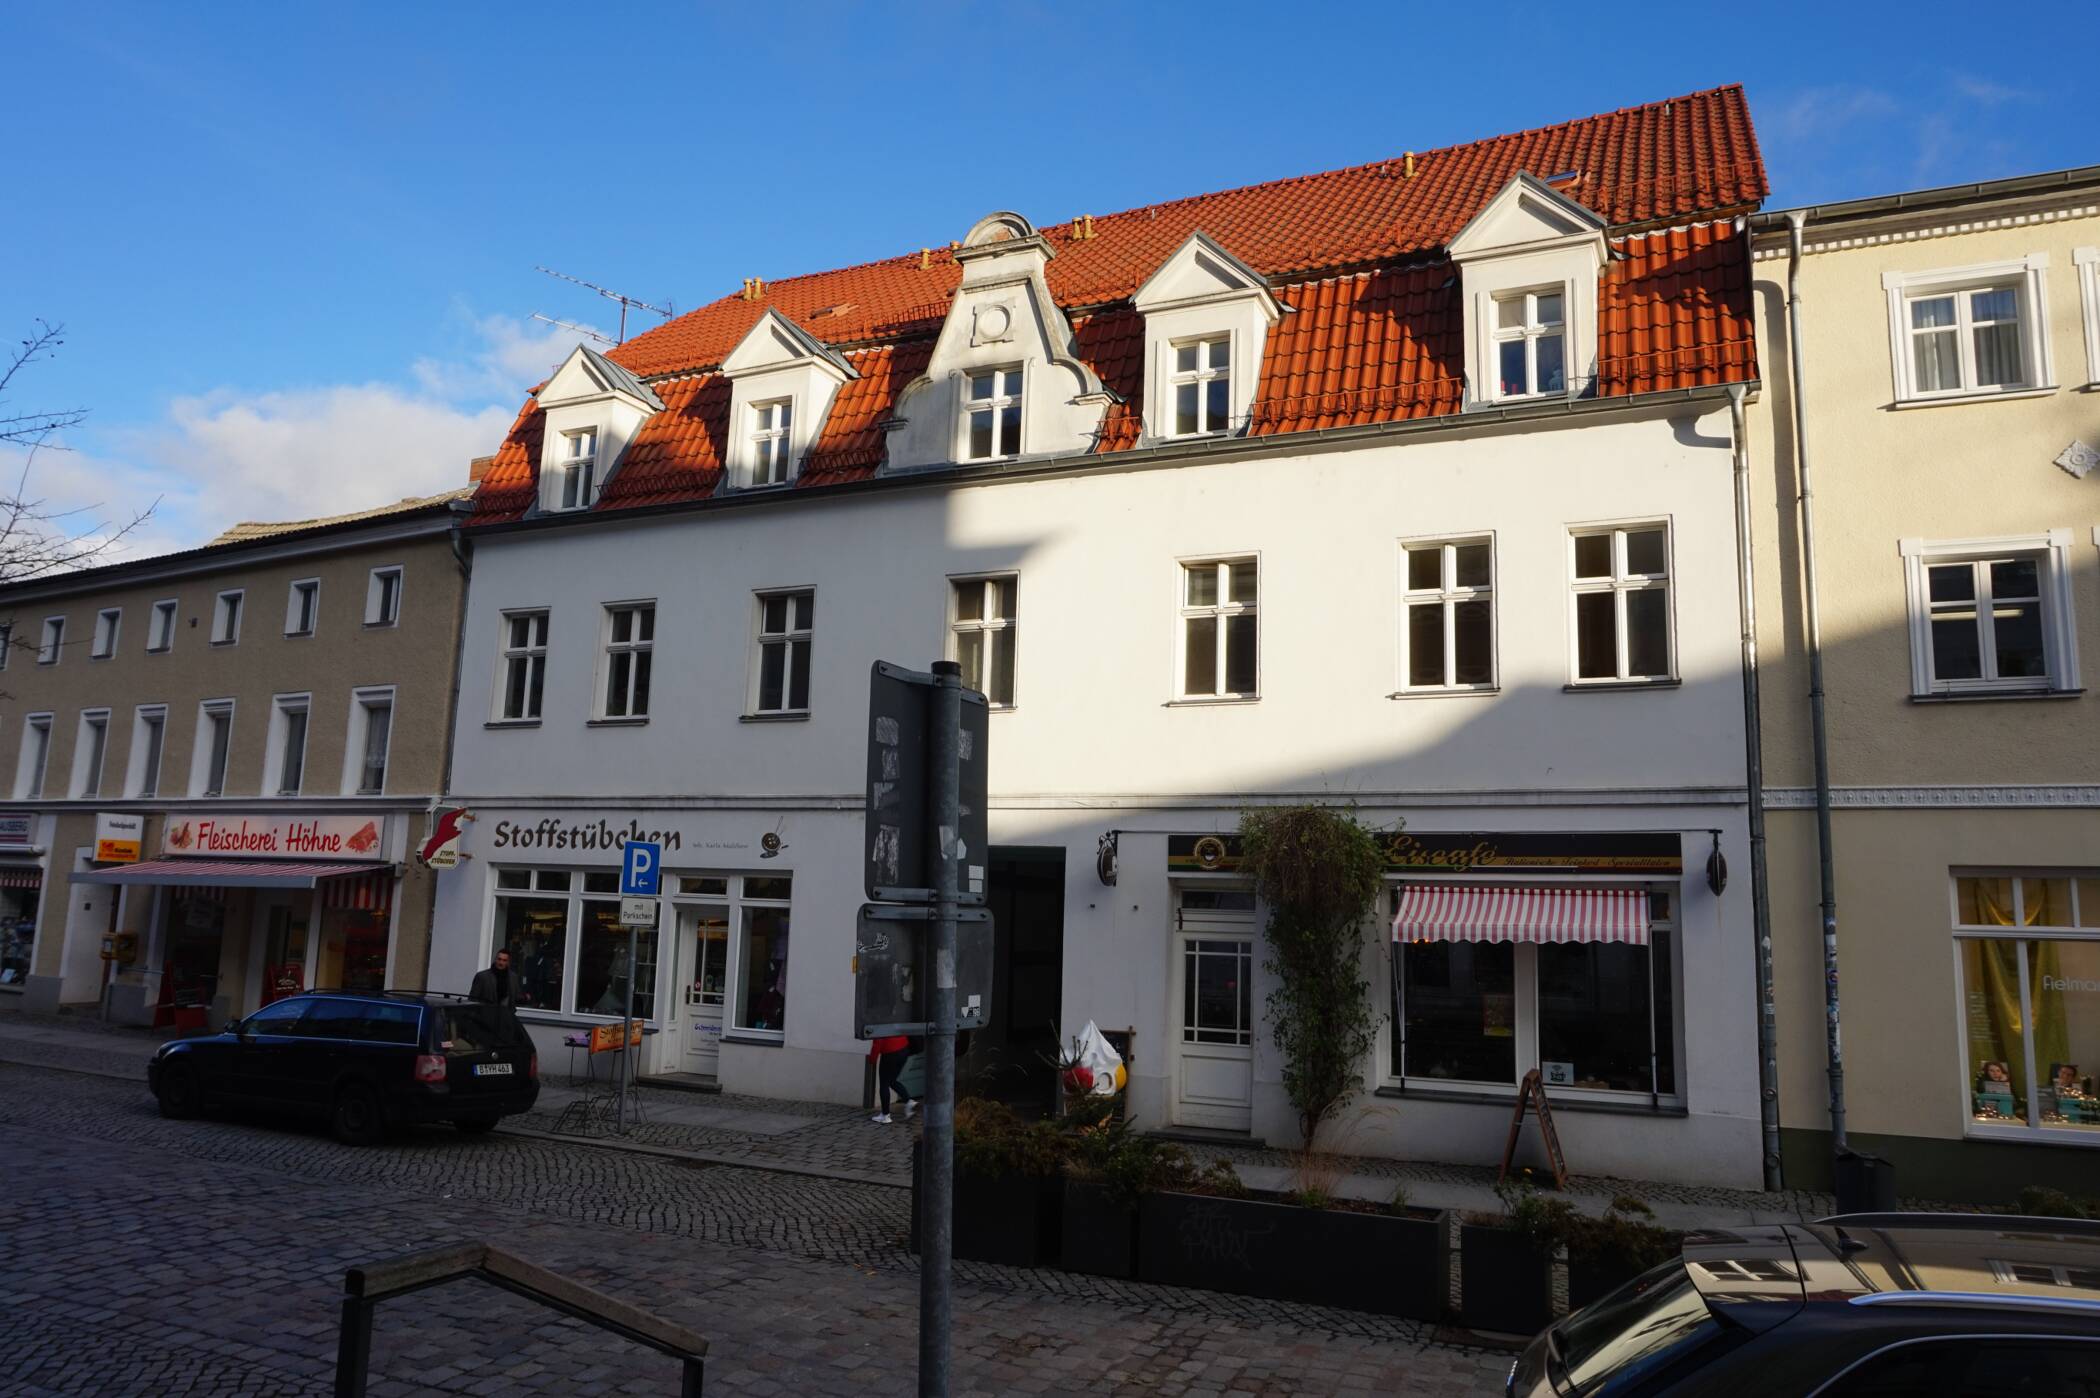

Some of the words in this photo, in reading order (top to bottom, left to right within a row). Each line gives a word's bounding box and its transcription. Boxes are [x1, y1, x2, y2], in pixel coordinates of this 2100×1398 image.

[197, 820, 278, 851] Fleischerei
[286, 820, 341, 852] Höhne
[494, 818, 681, 850] Stoffstübchen
[631, 848, 652, 888] P
[1384, 836, 1498, 871] Eiscafé
[623, 911, 653, 920] Parkschein
[634, 903, 644, 911] mit
